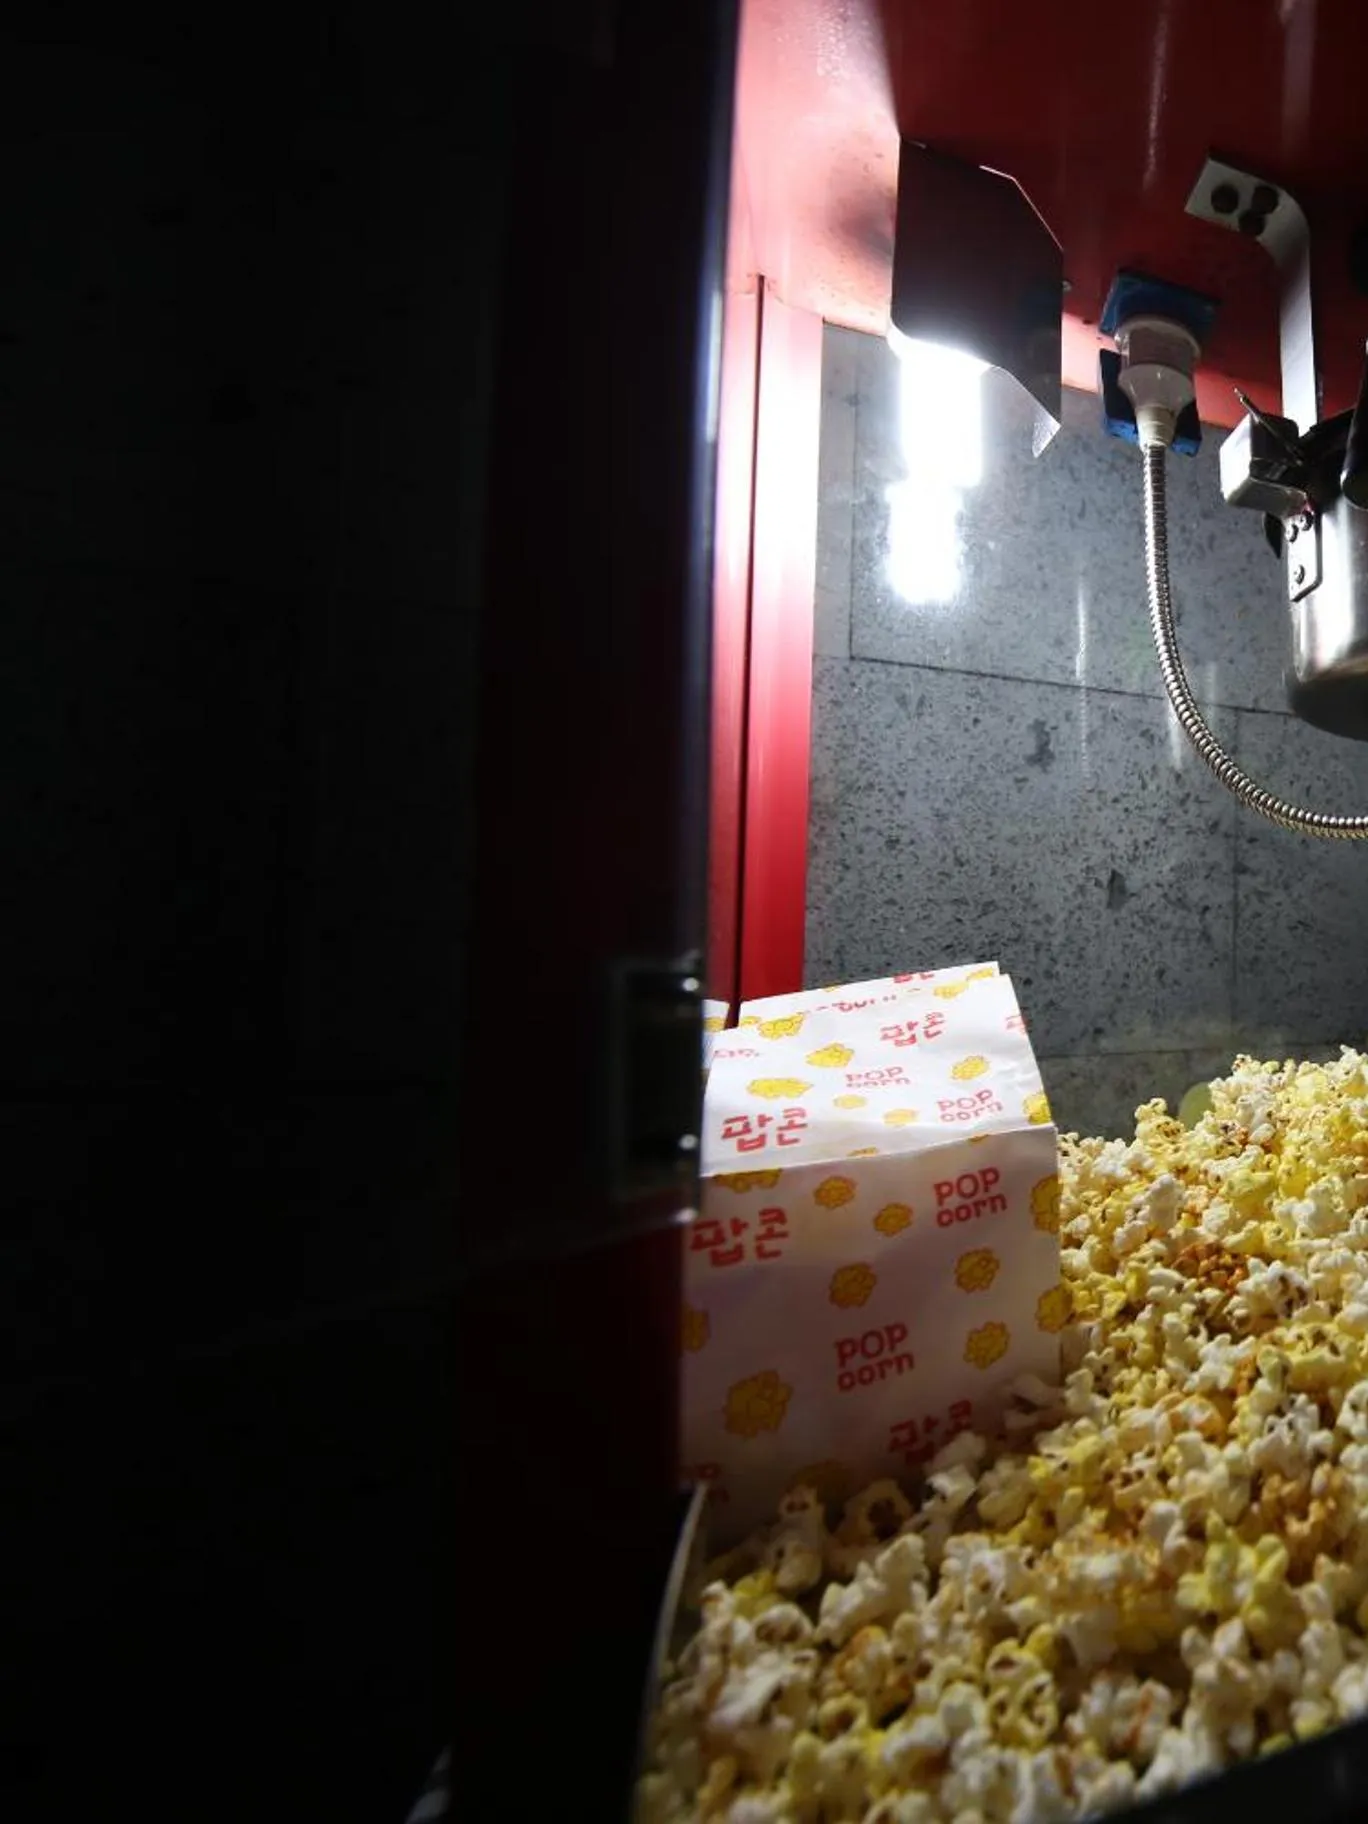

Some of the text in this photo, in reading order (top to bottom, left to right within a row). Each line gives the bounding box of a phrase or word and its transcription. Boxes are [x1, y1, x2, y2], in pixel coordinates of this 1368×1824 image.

[880, 1012, 945, 1047] 팝콘
[937, 1088, 993, 1111] POP
[721, 1107, 808, 1153] 팝콘
[933, 1166, 1000, 1206] POP
[937, 1193, 1007, 1227] corn
[690, 1207, 789, 1267] 팝콘
[834, 1322, 908, 1368] POP
[837, 1352, 915, 1391] corn
